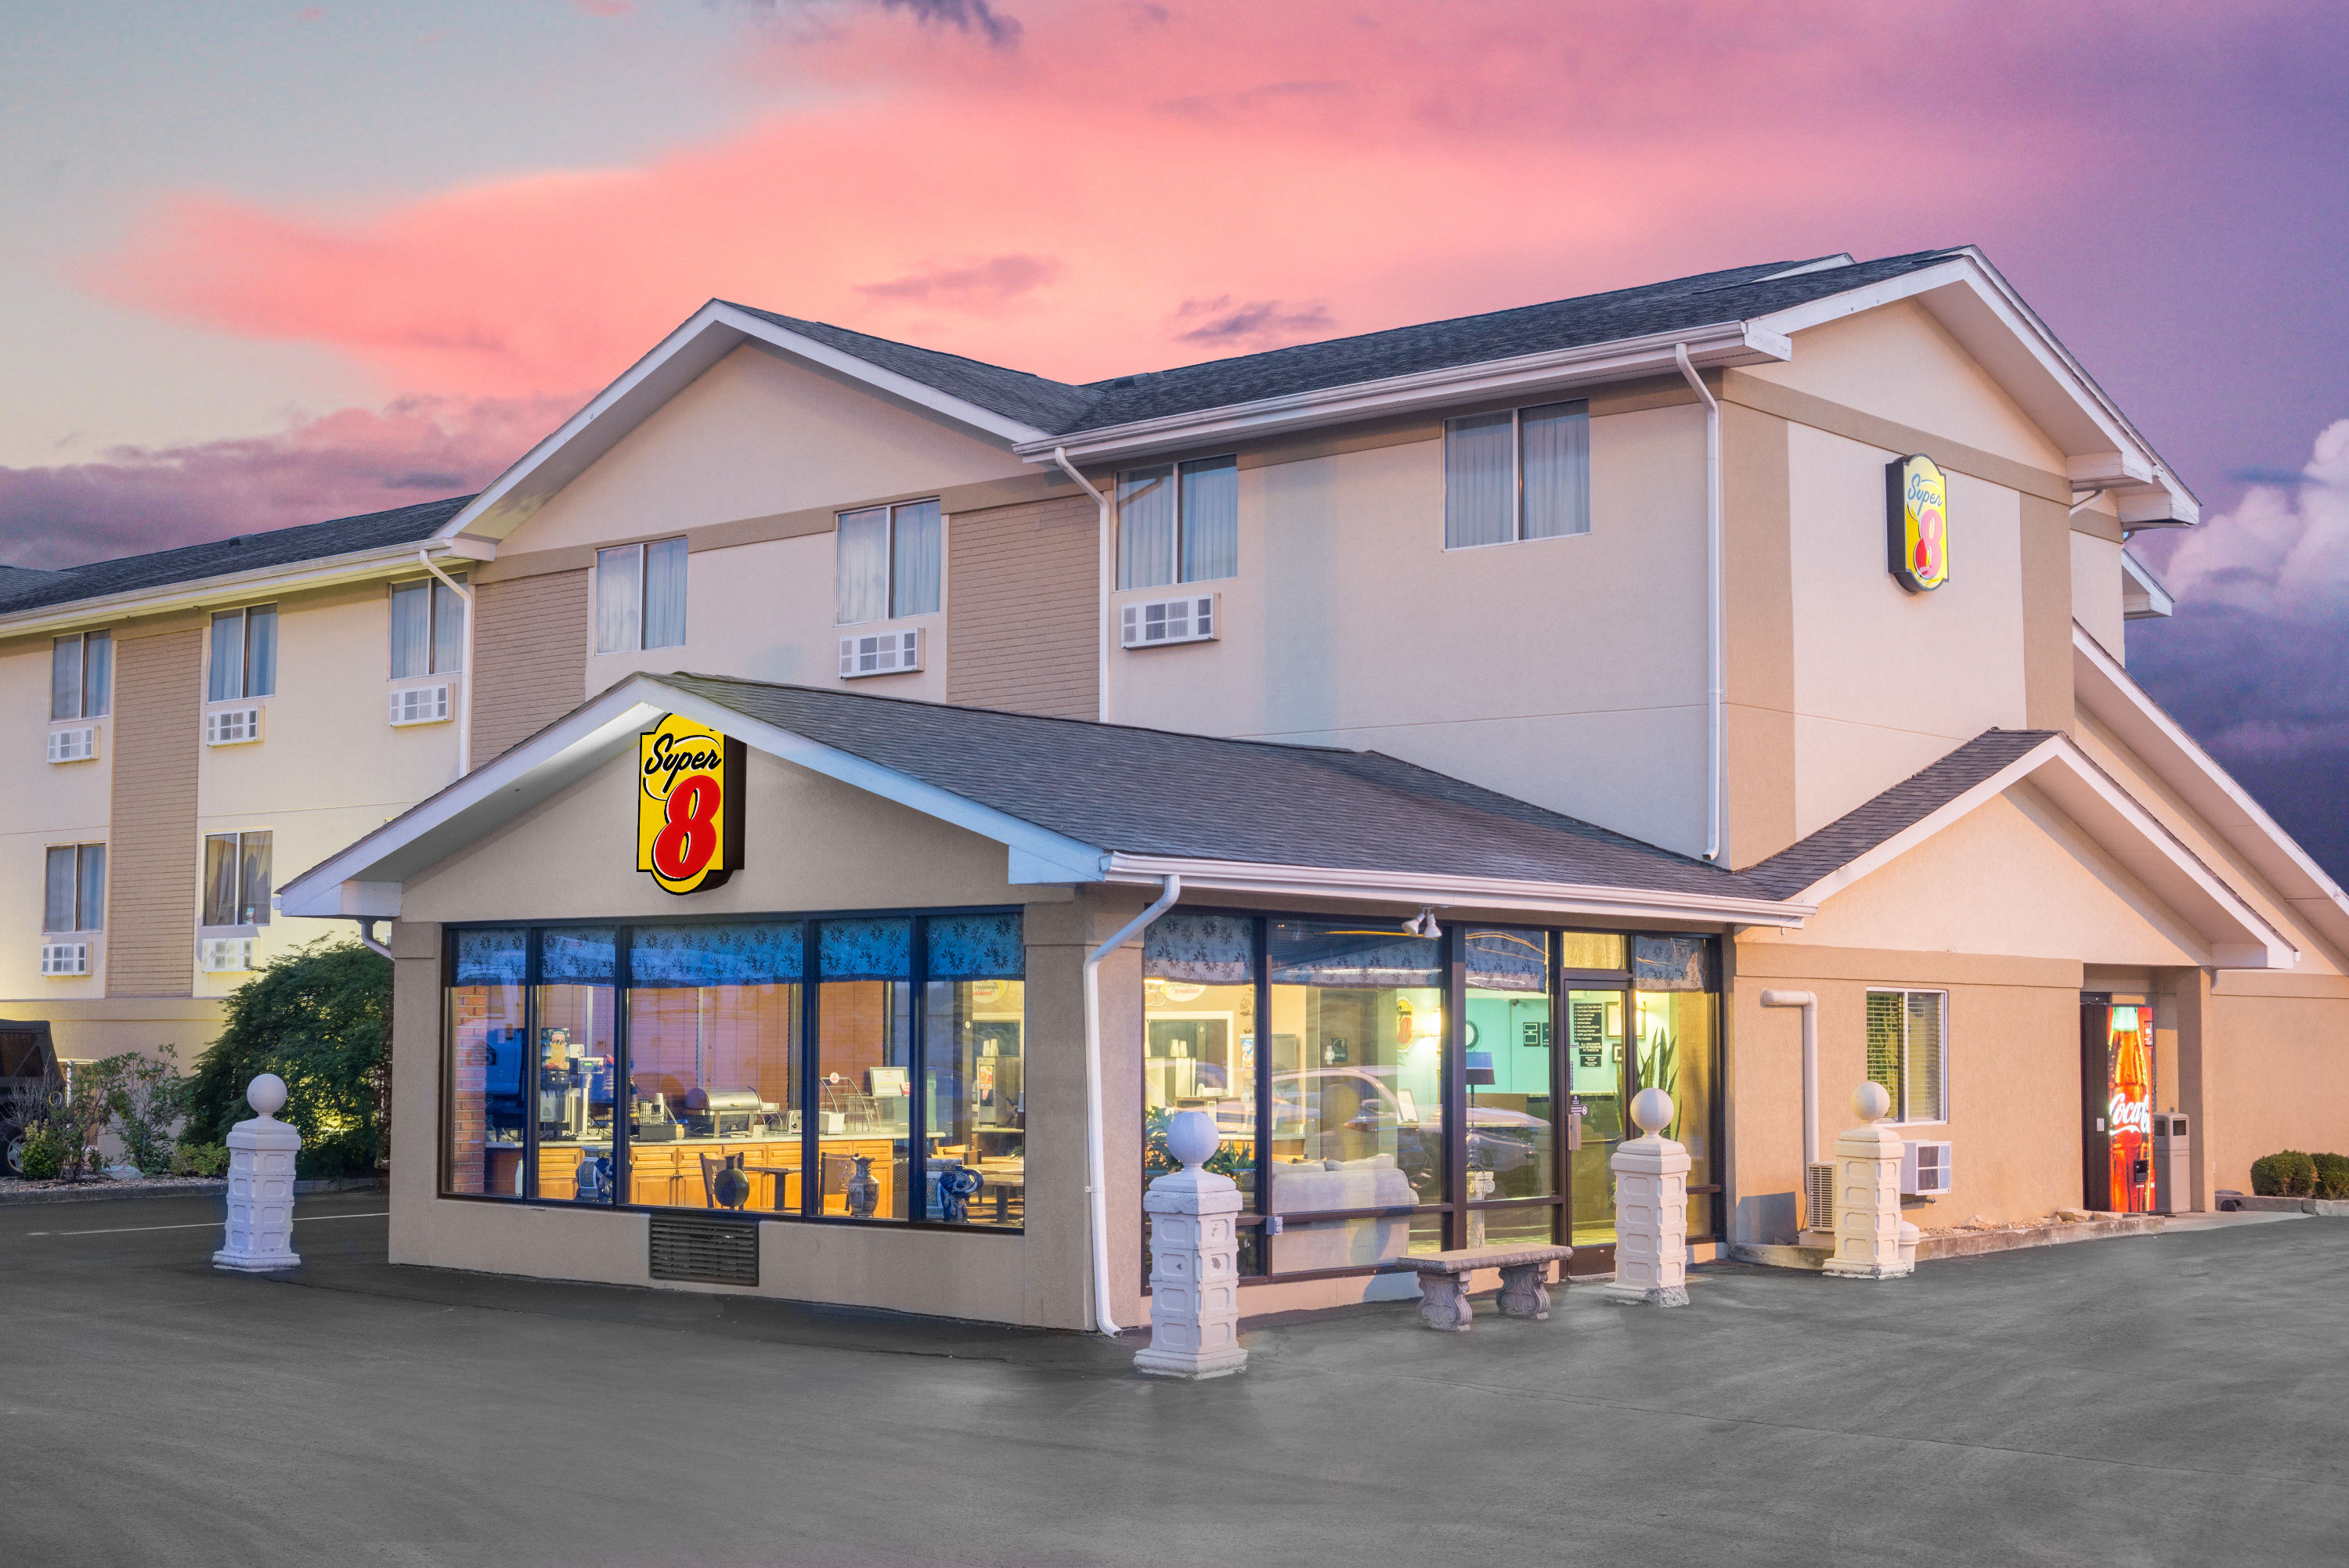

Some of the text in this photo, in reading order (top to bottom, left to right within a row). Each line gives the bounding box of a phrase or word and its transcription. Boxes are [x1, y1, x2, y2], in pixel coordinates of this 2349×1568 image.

[1907, 473, 1943, 516] Super
[1914, 509, 1943, 579] 8
[644, 734, 722, 794] Super
[651, 775, 721, 881] 8
[1397, 1005, 1412, 1022] Super
[1398, 1017, 1412, 1044] 8
